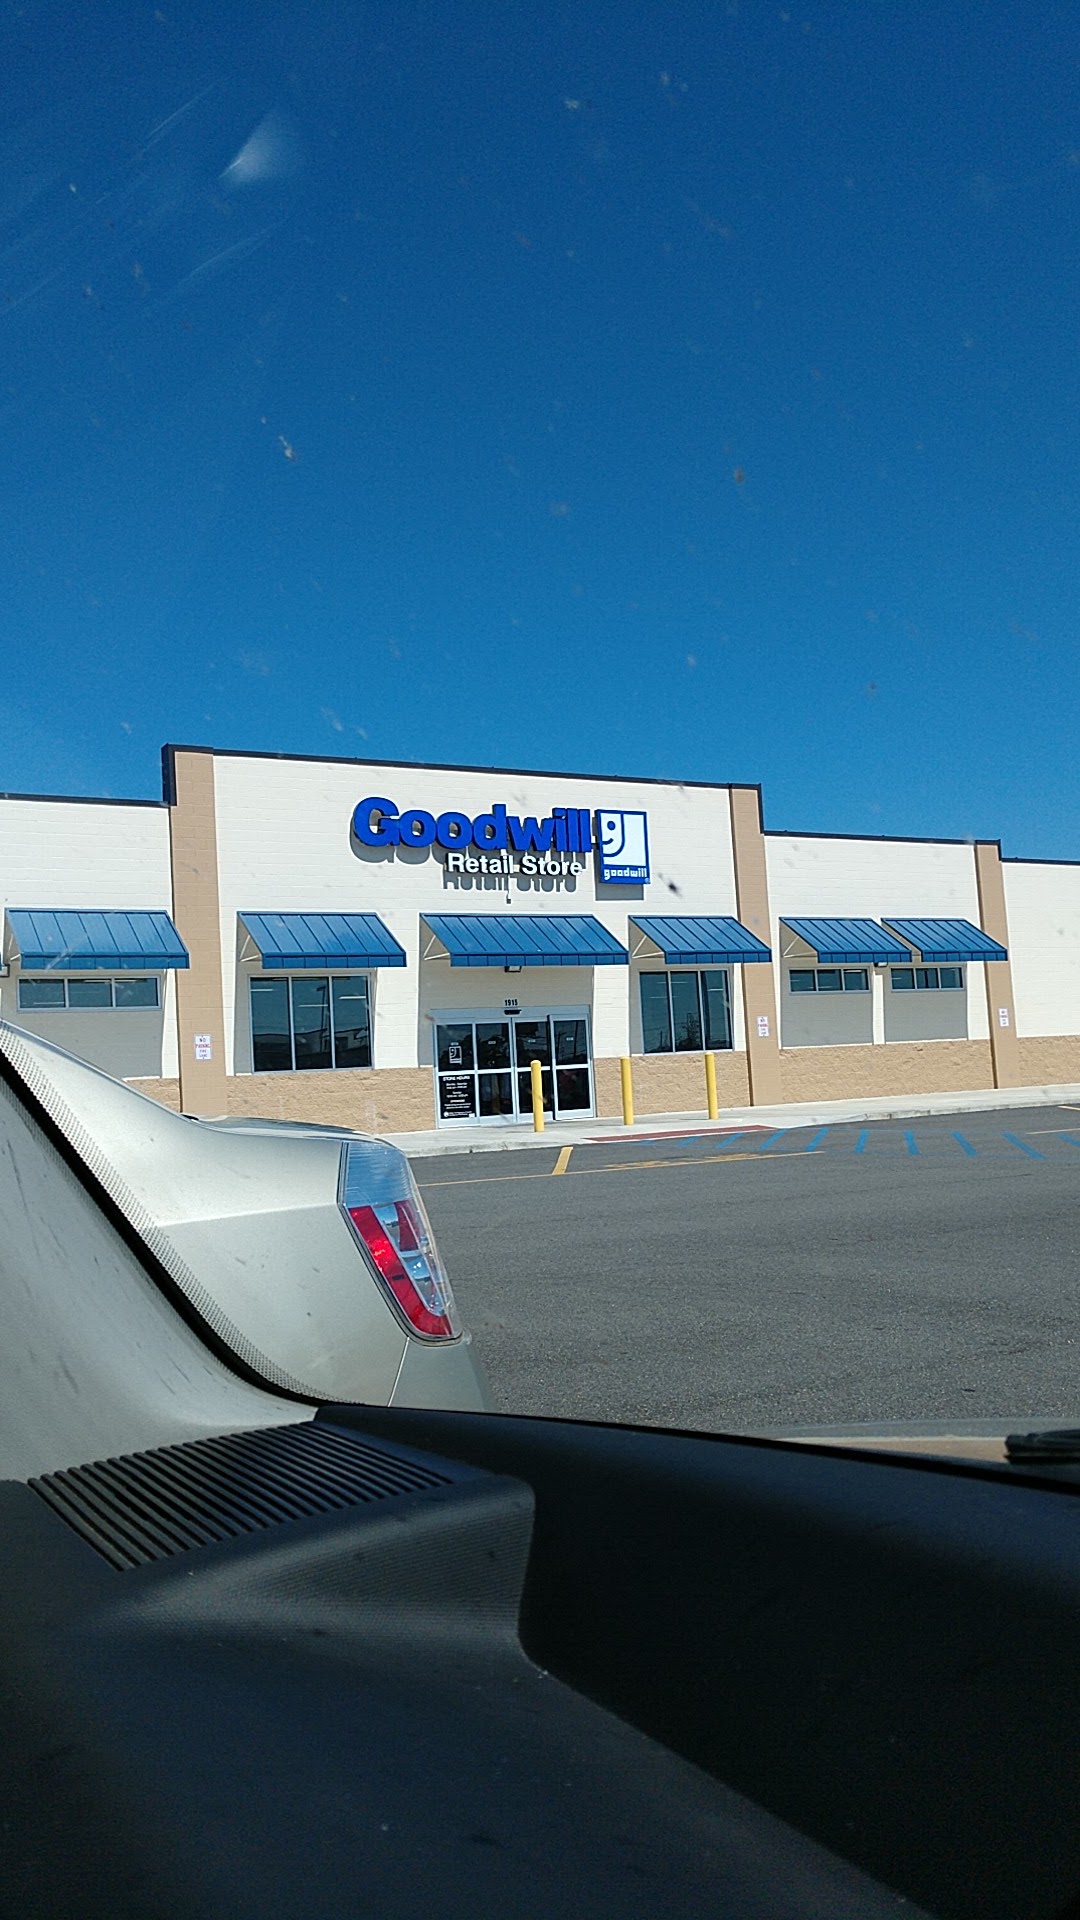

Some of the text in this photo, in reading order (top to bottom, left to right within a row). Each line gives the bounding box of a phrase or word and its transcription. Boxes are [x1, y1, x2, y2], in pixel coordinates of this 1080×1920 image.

[352, 796, 592, 853] Goodwill
[447, 852, 584, 877] Retail Store
[603, 867, 648, 881] goodwill
